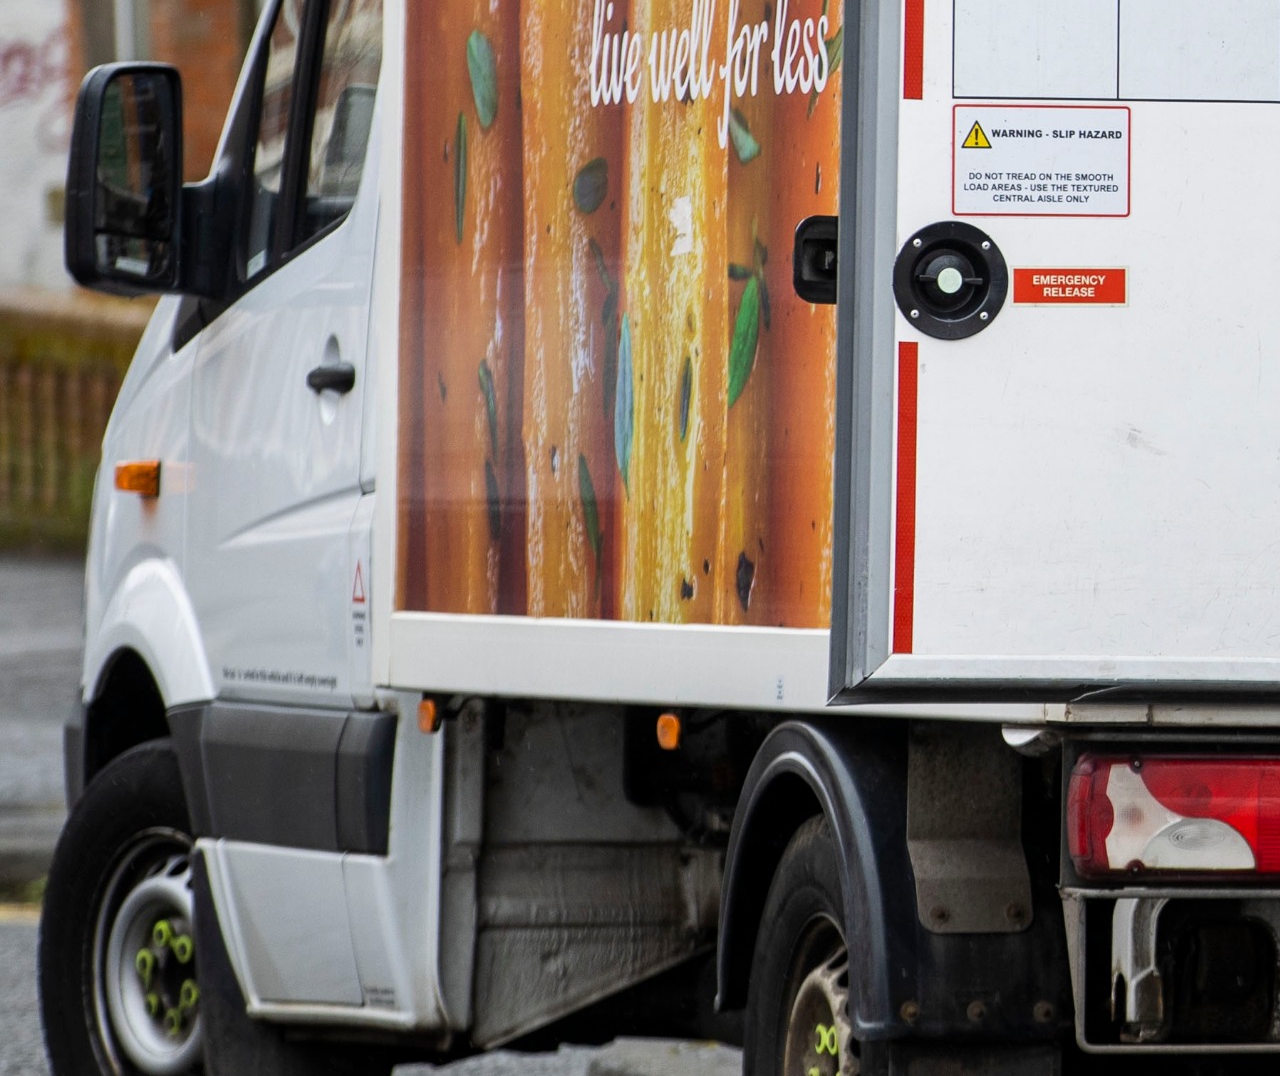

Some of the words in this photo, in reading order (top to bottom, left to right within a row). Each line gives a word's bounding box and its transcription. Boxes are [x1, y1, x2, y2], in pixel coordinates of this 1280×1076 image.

[992, 129, 1043, 138] WARNING
[1052, 130, 1076, 138] SLIP
[1078, 130, 1122, 140] HAZARD
[968, 172, 982, 180] DO
[1006, 173, 1036, 181] TREAD
[1038, 173, 1052, 181] ON
[1074, 174, 1114, 182] SMOOTH
[991, 184, 1022, 192] AREAS
[1030, 184, 1048, 192] USE
[1051, 184, 1068, 192] THE
[1071, 185, 1118, 193] TEXTURED
[1037, 195, 1063, 203] AISLE
[1066, 195, 1090, 203] ONLY
[1032, 274, 1106, 286] EMERGENCY
[1043, 286, 1095, 298] RELEASE
